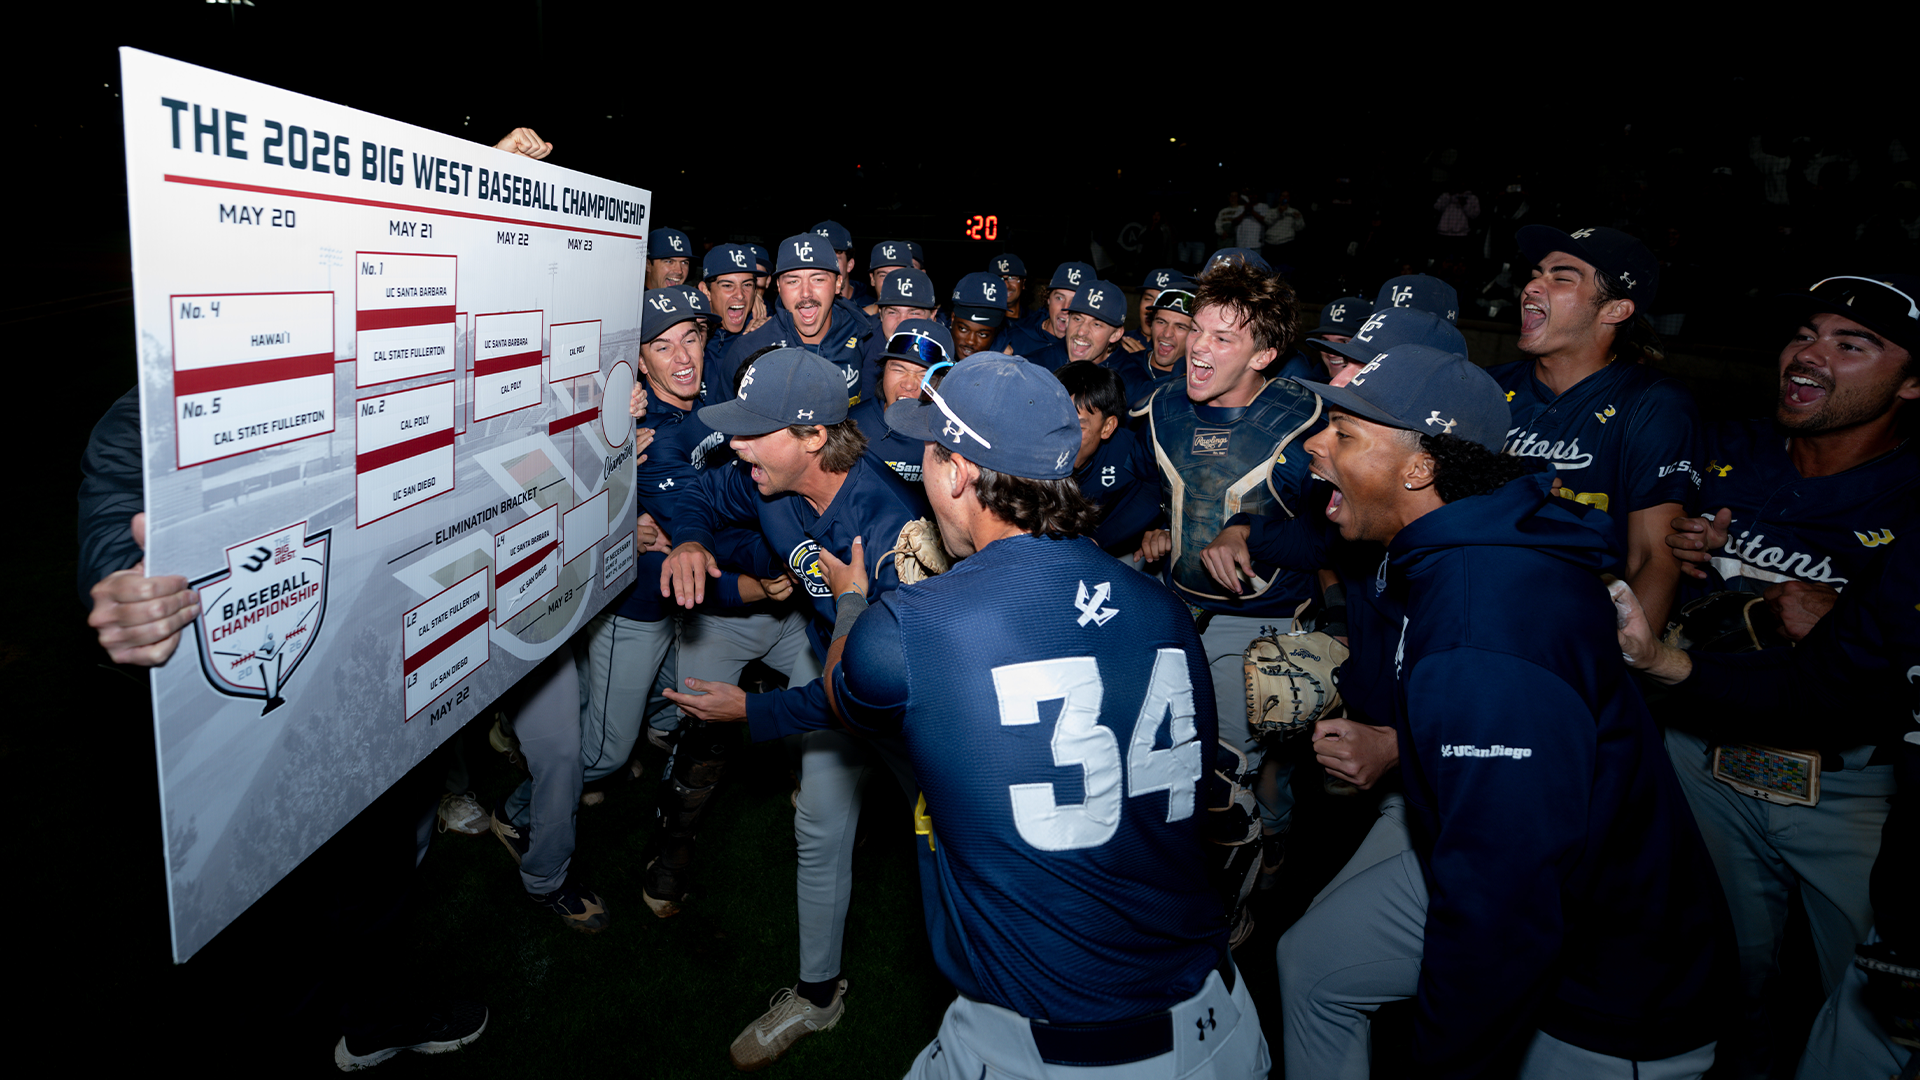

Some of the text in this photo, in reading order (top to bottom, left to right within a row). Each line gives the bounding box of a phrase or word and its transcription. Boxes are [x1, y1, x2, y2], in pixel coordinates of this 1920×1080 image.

[161, 96, 646, 226] THE 2026 BIG WEST BASEBALL CHAMPIONSHIP
[219, 203, 296, 228] MAY 20
[389, 219, 433, 239] MAY 21
[966, 215, 998, 241] :20
[497, 231, 529, 246] MAY 22
[567, 238, 593, 251] MAY 23
[668, 235, 684, 252] UC
[729, 249, 748, 268] UC
[793, 241, 814, 262] UC
[882, 245, 897, 260] UC
[361, 261, 384, 276] No. 1
[997, 259, 1010, 273] UC
[897, 277, 913, 297] UC
[1067, 268, 1081, 286] UC
[386, 286, 447, 298] UC SANTA BARBARA
[682, 291, 702, 310] UC
[982, 282, 997, 302] UC
[1087, 288, 1104, 310] UC
[1391, 285, 1413, 307] UC
[180, 301, 221, 320] No. 4
[648, 293, 677, 314] UC
[1329, 304, 1346, 323] UC
[1357, 313, 1388, 343] UC
[484, 337, 528, 349] UC SANTA BARBARA
[569, 347, 577, 357] CAL
[374, 346, 446, 362] CAL STATE FULLERTON
[501, 380, 522, 395] CAL POLY
[183, 397, 222, 420] No. 5
[361, 399, 386, 417] No. 2
[214, 409, 325, 446] CAL STATE FULLERTON
[400, 415, 430, 431] CAL POLY
[1501, 426, 1592, 470] itons
[393, 476, 436, 501] UC SAN DIEGO
[435, 486, 538, 546] ELIMINATION BRACKET
[274, 534, 291, 548] THE
[275, 543, 290, 557] BIG
[496, 534, 506, 548] L4
[509, 529, 550, 557] UC SANTA BARBARA
[1701, 512, 1849, 585] itons
[274, 549, 297, 566] WEST
[519, 563, 547, 595] UC SAN DIEGO
[794, 568, 831, 594] BASEBAL
[223, 571, 310, 622] BASEBALL
[548, 588, 574, 616] MAY 23
[212, 582, 319, 643] CHAMPIONSHIP
[406, 612, 417, 629] L2
[418, 591, 480, 637] CAL STATE FULLERTON
[407, 673, 418, 690] L3
[430, 656, 468, 691] UC SAN DIEGO
[430, 686, 470, 726] MAY 22
[991, 647, 1203, 852] 34
